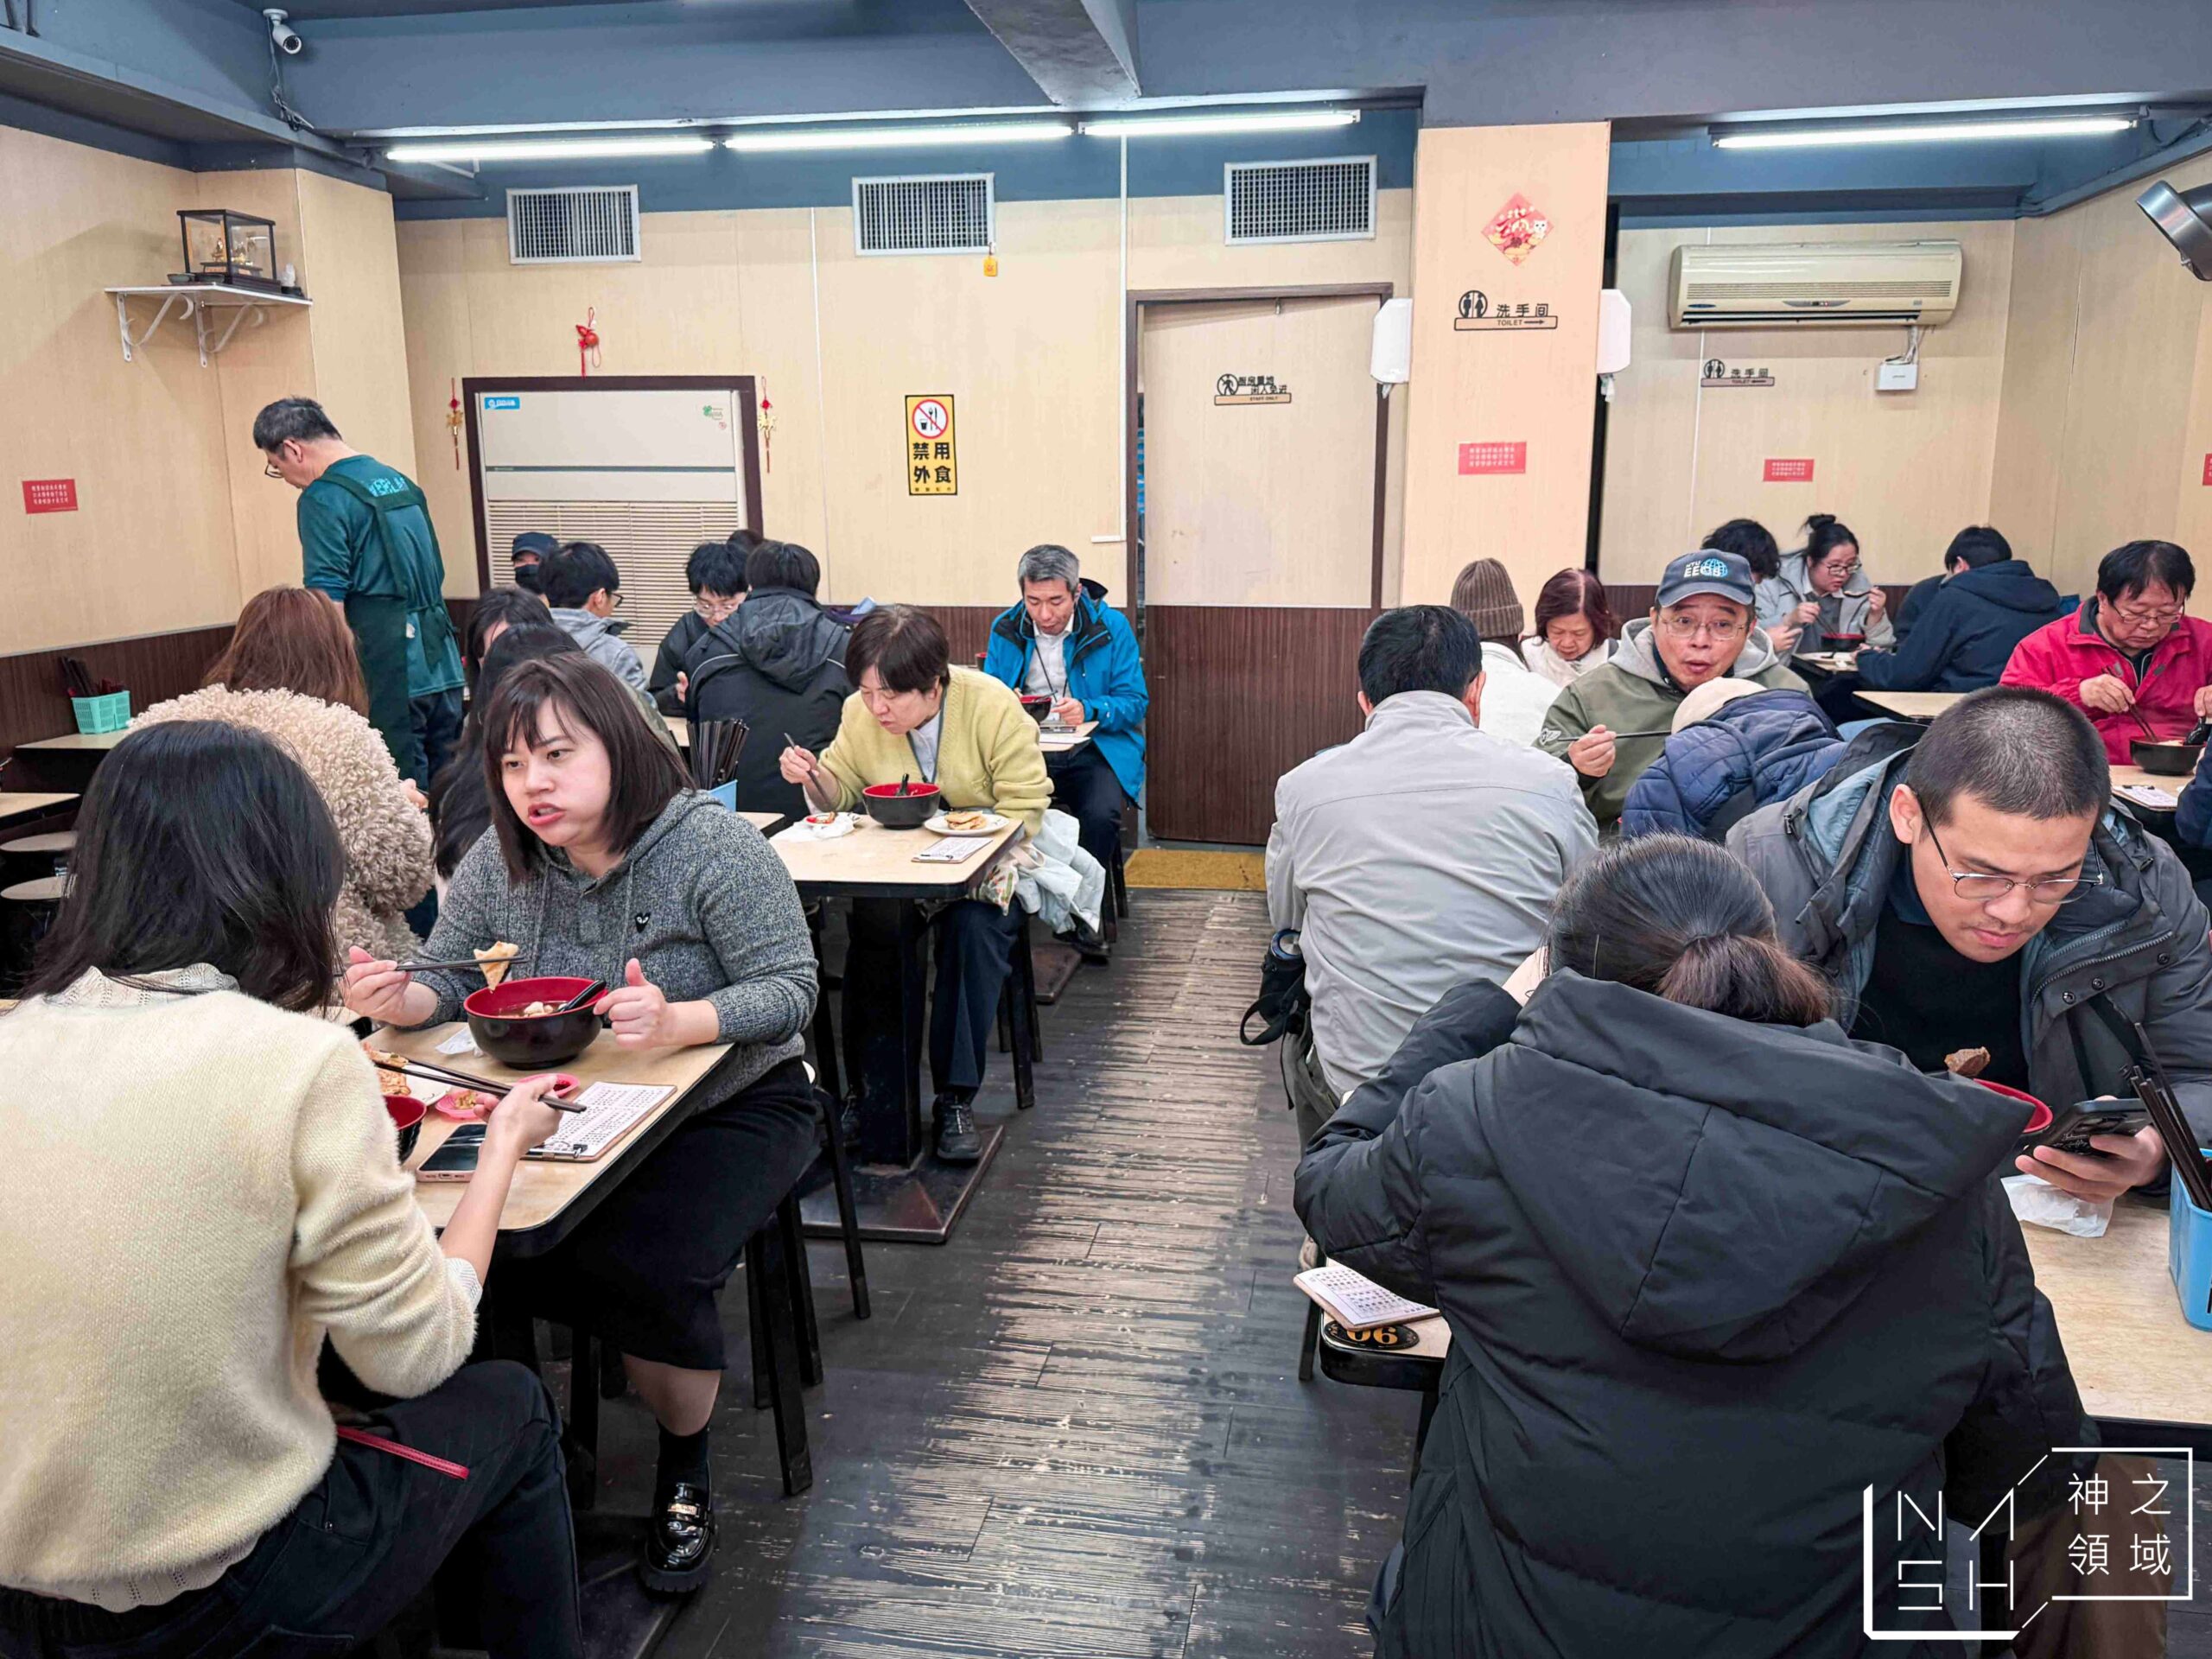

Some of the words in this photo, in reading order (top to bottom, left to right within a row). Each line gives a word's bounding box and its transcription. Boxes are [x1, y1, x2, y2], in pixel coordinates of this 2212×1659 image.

[1497, 303, 1548, 317] 洗手间
[912, 442, 950, 461] 禁用
[913, 465, 951, 484] 外食
[1346, 1327, 1398, 1344] 06
